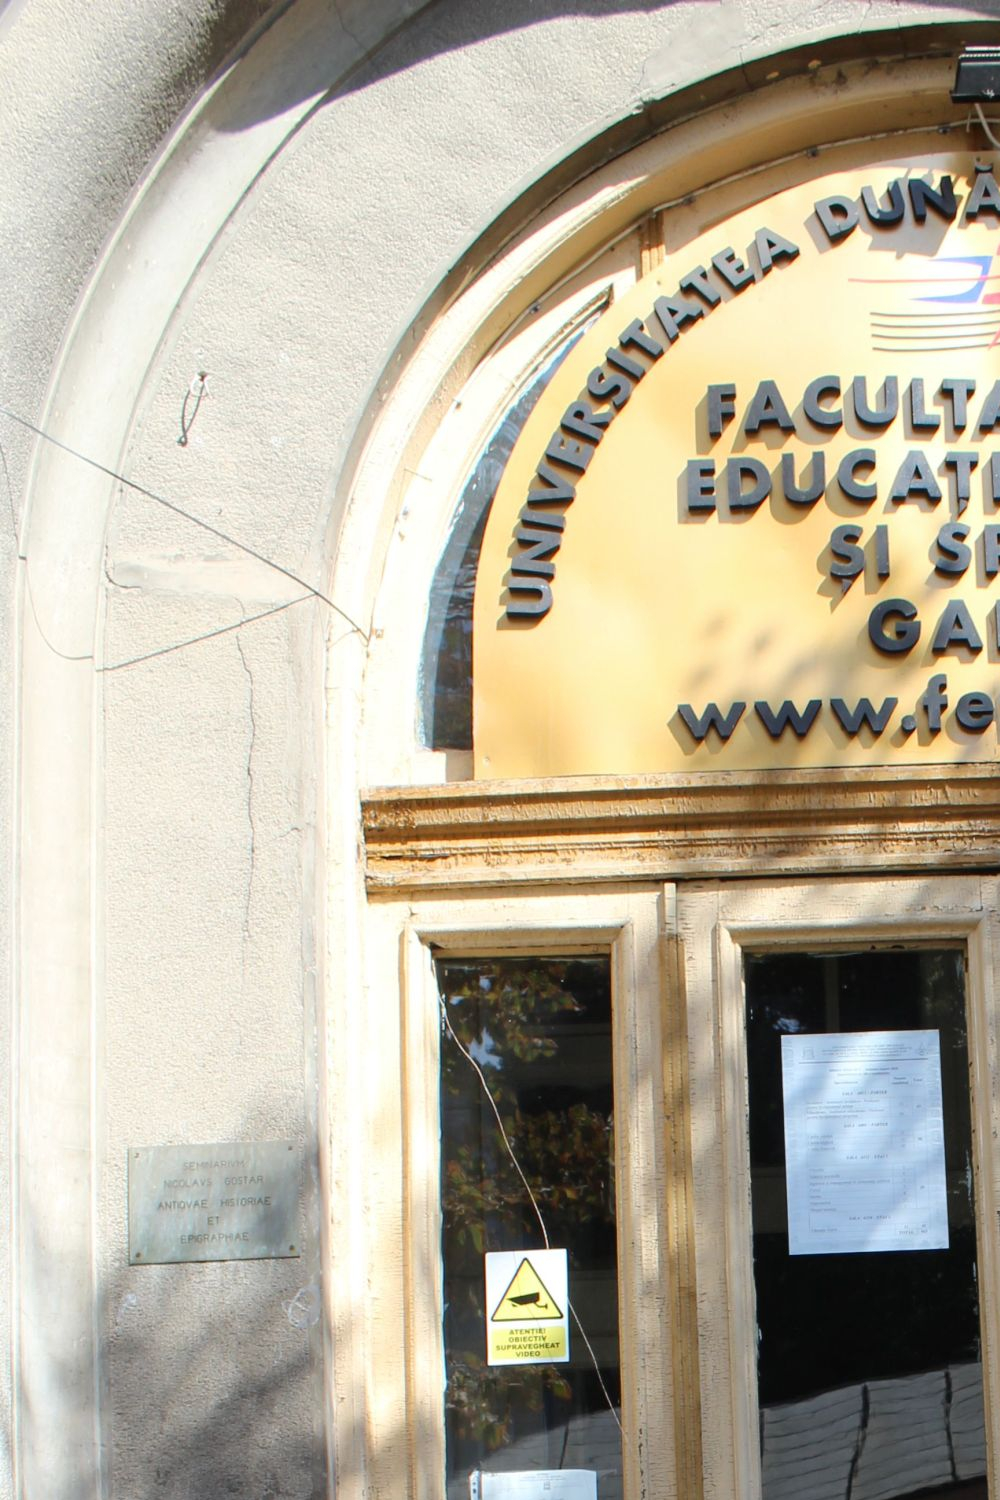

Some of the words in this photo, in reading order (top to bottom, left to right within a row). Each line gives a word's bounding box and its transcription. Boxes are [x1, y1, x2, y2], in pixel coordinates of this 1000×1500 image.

[505, 227, 799, 619] UNIVERSITATEA
[828, 524, 890, 594] ȘI
[224, 1175, 264, 1186] GOSTAR
[220, 1196, 272, 1208] HISTORIAE
[207, 1216, 220, 1226] ET
[508, 1335, 547, 1343] OBIECTIV
[495, 1342, 560, 1351] SUPRAVEGHEAT
